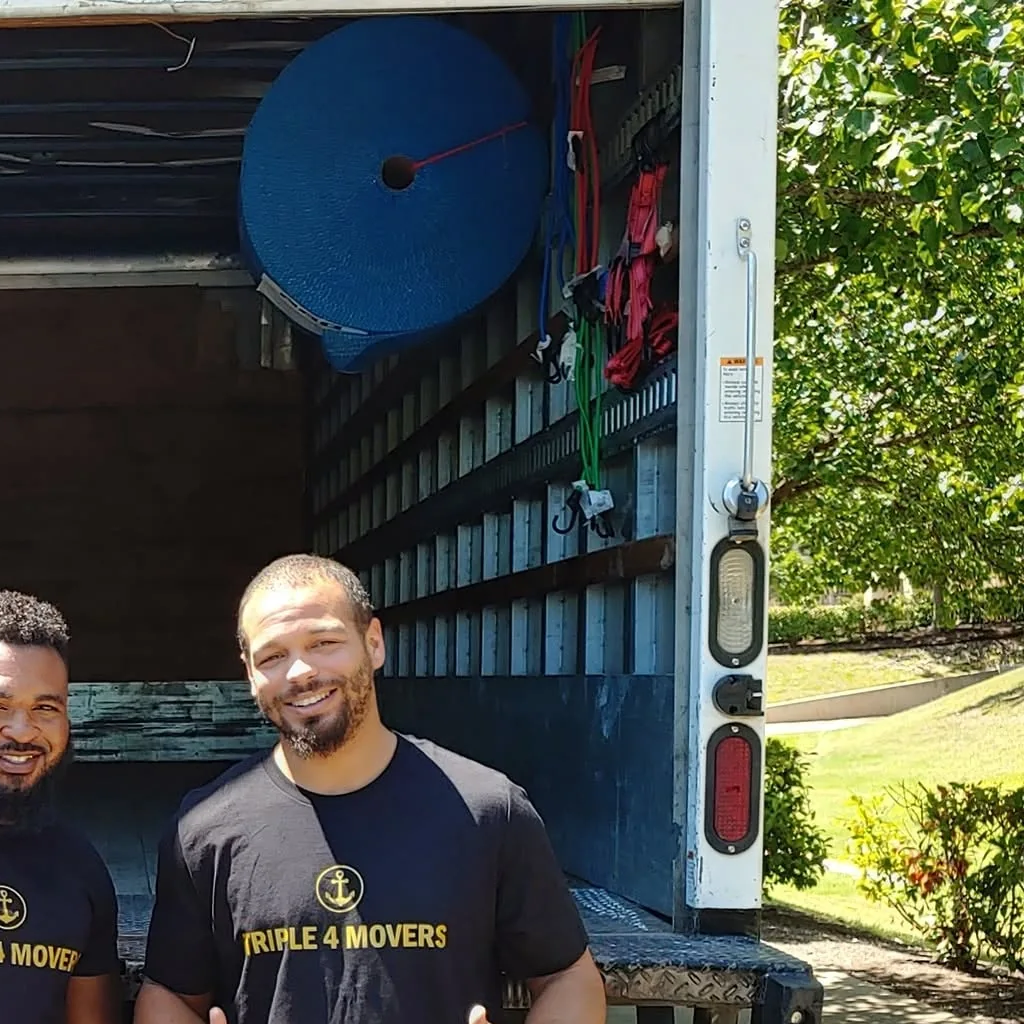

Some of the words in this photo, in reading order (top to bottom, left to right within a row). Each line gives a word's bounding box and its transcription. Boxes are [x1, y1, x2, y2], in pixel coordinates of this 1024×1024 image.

[242, 925, 318, 957] TRIPLE
[322, 925, 340, 950] 4
[344, 923, 448, 949] MOVERS
[10, 943, 81, 973] MOVER
